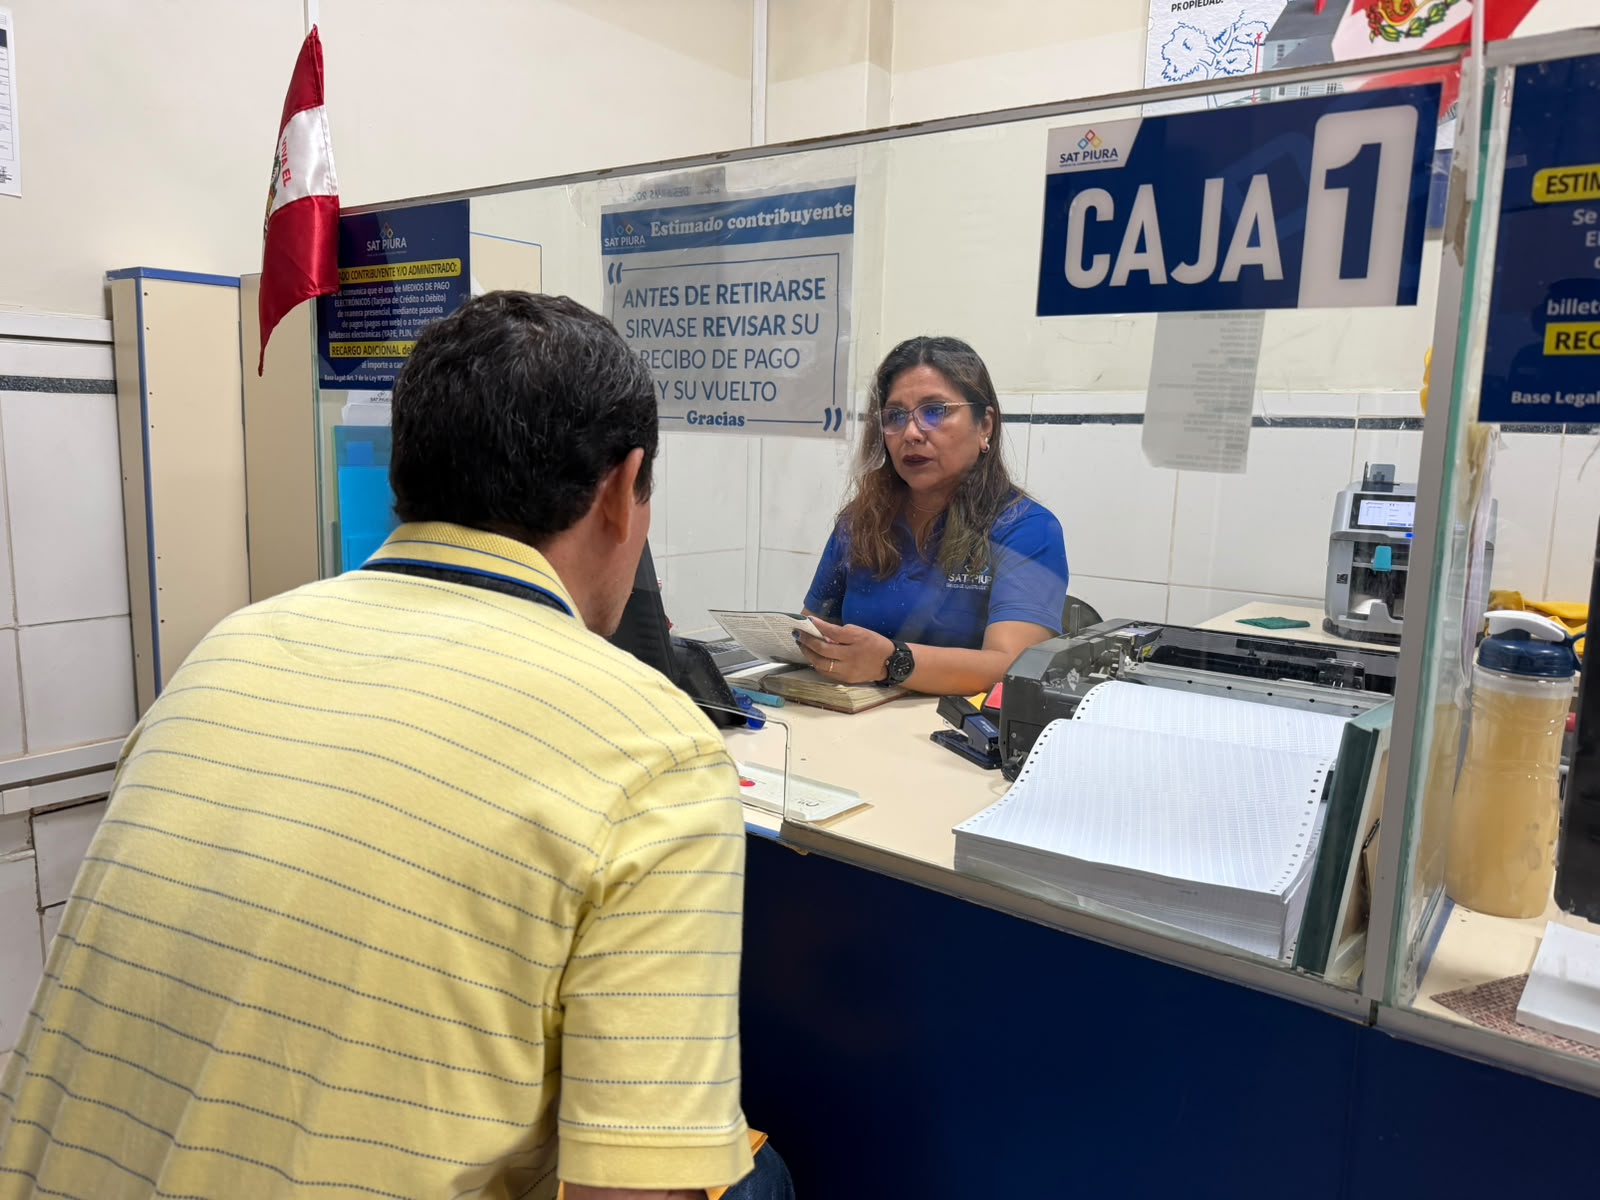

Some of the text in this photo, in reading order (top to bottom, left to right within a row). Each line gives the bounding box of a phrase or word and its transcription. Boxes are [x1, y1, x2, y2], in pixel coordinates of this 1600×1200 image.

[1059, 152, 1080, 164] SAT
[1082, 148, 1118, 161] PIURA
[282, 168, 291, 187] EL
[650, 202, 853, 237] Estimado contribuyente
[1064, 142, 1382, 289] CAJA 1
[1572, 208, 1598, 226] Se
[366, 237, 407, 252] SAT PIURA
[604, 235, 646, 247] SAT PIURA
[351, 267, 395, 280] CONTRIBUYENTE
[396, 266, 408, 277] Y/O
[408, 262, 457, 276] ADMINISTRADO:
[394, 285, 401, 293] de
[402, 283, 425, 292] MEDIOS
[425, 282, 433, 291] DE
[434, 281, 450, 290] PAGO
[622, 277, 826, 308] ANTES DE RETIRARSE
[391, 296, 399, 304] de
[400, 294, 420, 304] Crédito
[425, 293, 447, 303] Débito)
[419, 305, 444, 316] pasarela
[625, 313, 819, 339] SIRVASE REVISAR SU
[332, 345, 362, 356] RECARGO
[363, 344, 401, 356] ADICIONAL
[368, 361, 388, 371] importe
[639, 347, 800, 370] RECIBO DE PAGO
[657, 380, 777, 402] Y SU VUELTO
[1511, 390, 1551, 405] Base
[686, 410, 745, 427] Gracias
[947, 573, 969, 583] SAT
